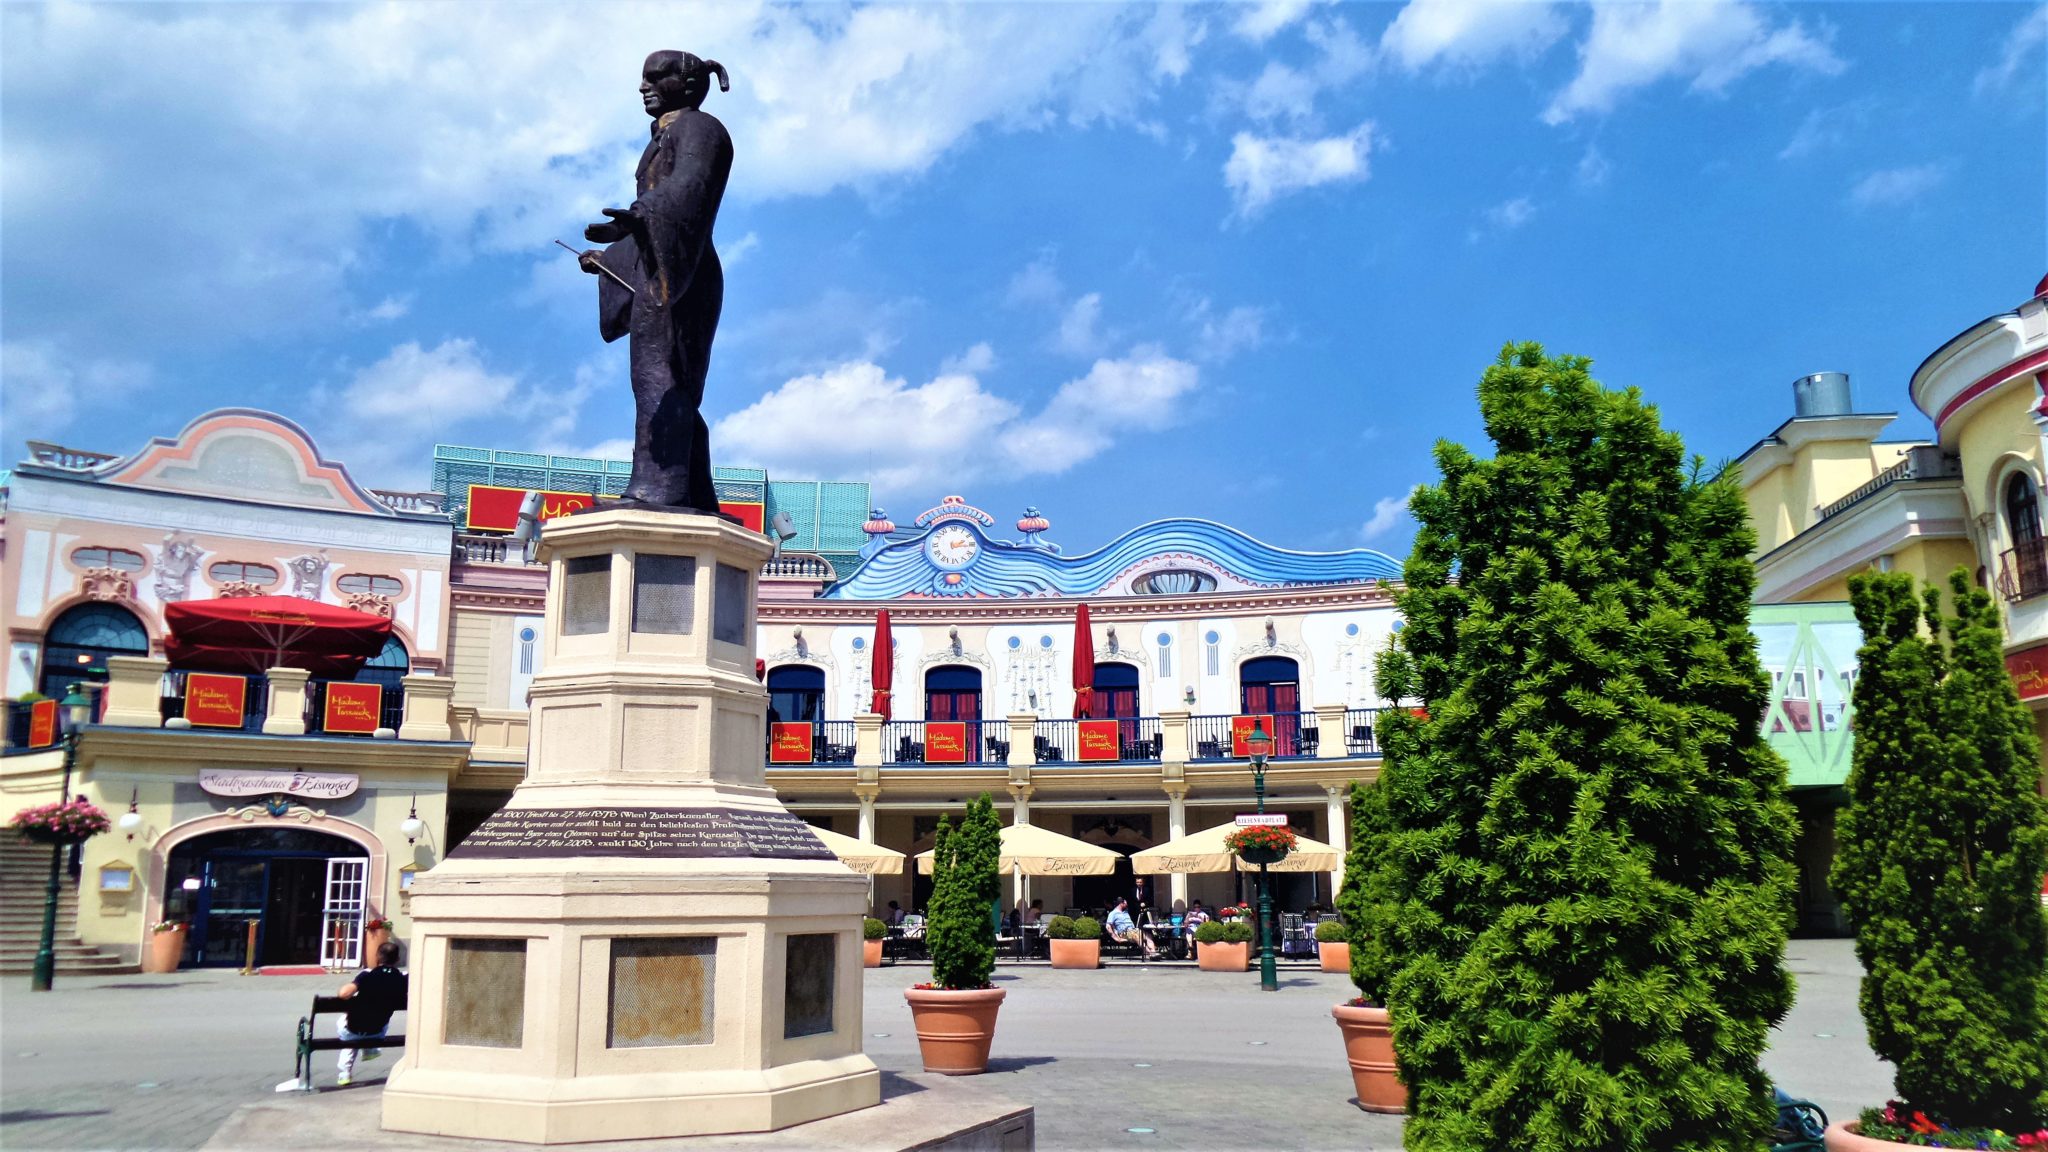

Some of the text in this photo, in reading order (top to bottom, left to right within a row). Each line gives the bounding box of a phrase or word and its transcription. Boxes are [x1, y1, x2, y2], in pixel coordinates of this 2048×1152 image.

[192, 686, 229, 698] Madame
[331, 694, 367, 706] Madame
[775, 731, 802, 741] Madame
[929, 731, 955, 741] Madame
[1081, 729, 1109, 740] Madame
[204, 773, 354, 796] Stadtgasthaus Eisvogel
[560, 810, 574, 819] 27.
[590, 810, 618, 819] 1878
[602, 820, 621, 828] bald
[659, 821, 709, 829] beliebtesten
[638, 830, 667, 840] Spitze
[532, 839, 546, 848] 27.
[628, 840, 646, 848] 130
[645, 839, 673, 851] Jahre
[701, 840, 718, 848] dem
[1043, 857, 1088, 874] Eisvogel
[1159, 856, 1203, 872] Eisvogel
[1276, 858, 1308, 871] isvogel
